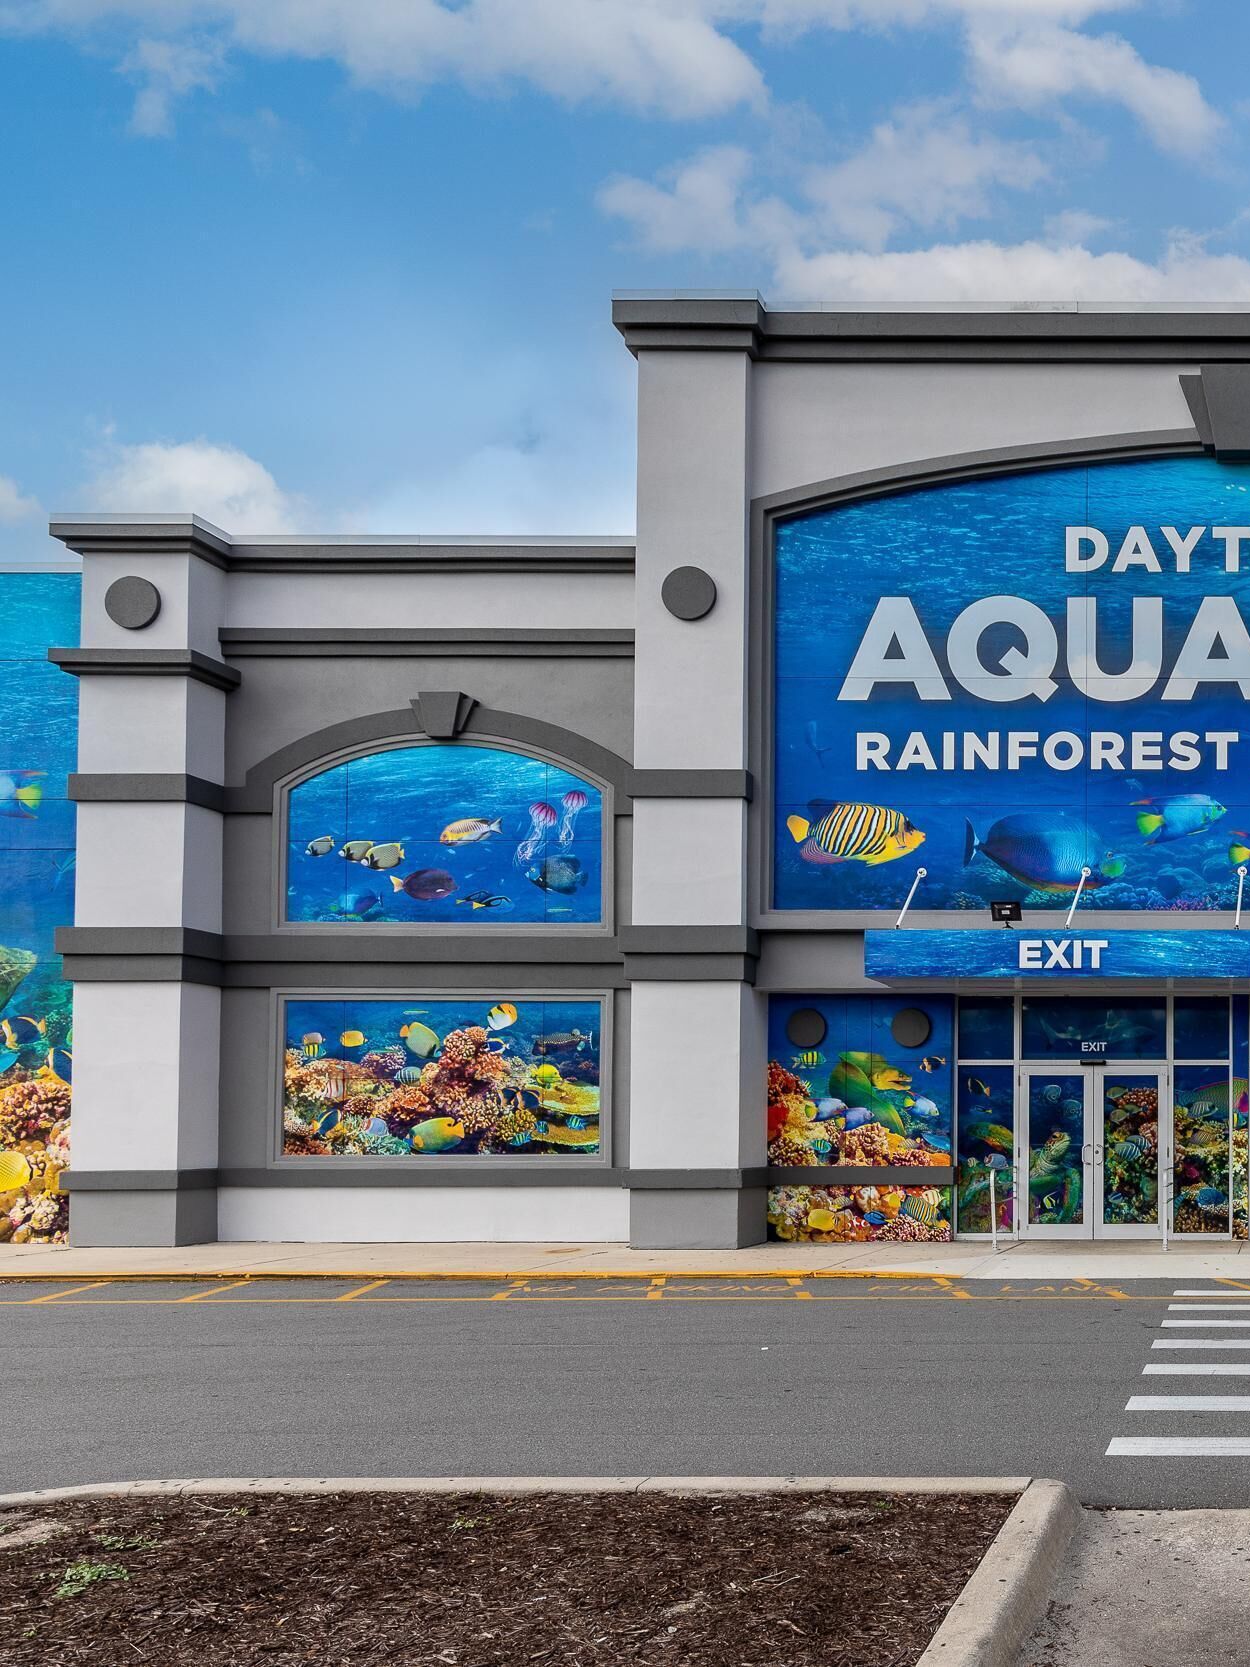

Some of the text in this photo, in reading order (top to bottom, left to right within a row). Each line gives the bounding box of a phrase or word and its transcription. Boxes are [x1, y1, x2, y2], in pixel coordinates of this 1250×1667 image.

[856, 731, 1239, 771] RAINFOREST
[1018, 939, 1109, 969] EXIT
[1081, 1041, 1107, 1052] EXIT
[595, 1285, 795, 1293] PARKING
[867, 1285, 1122, 1293] FIRE LANE
